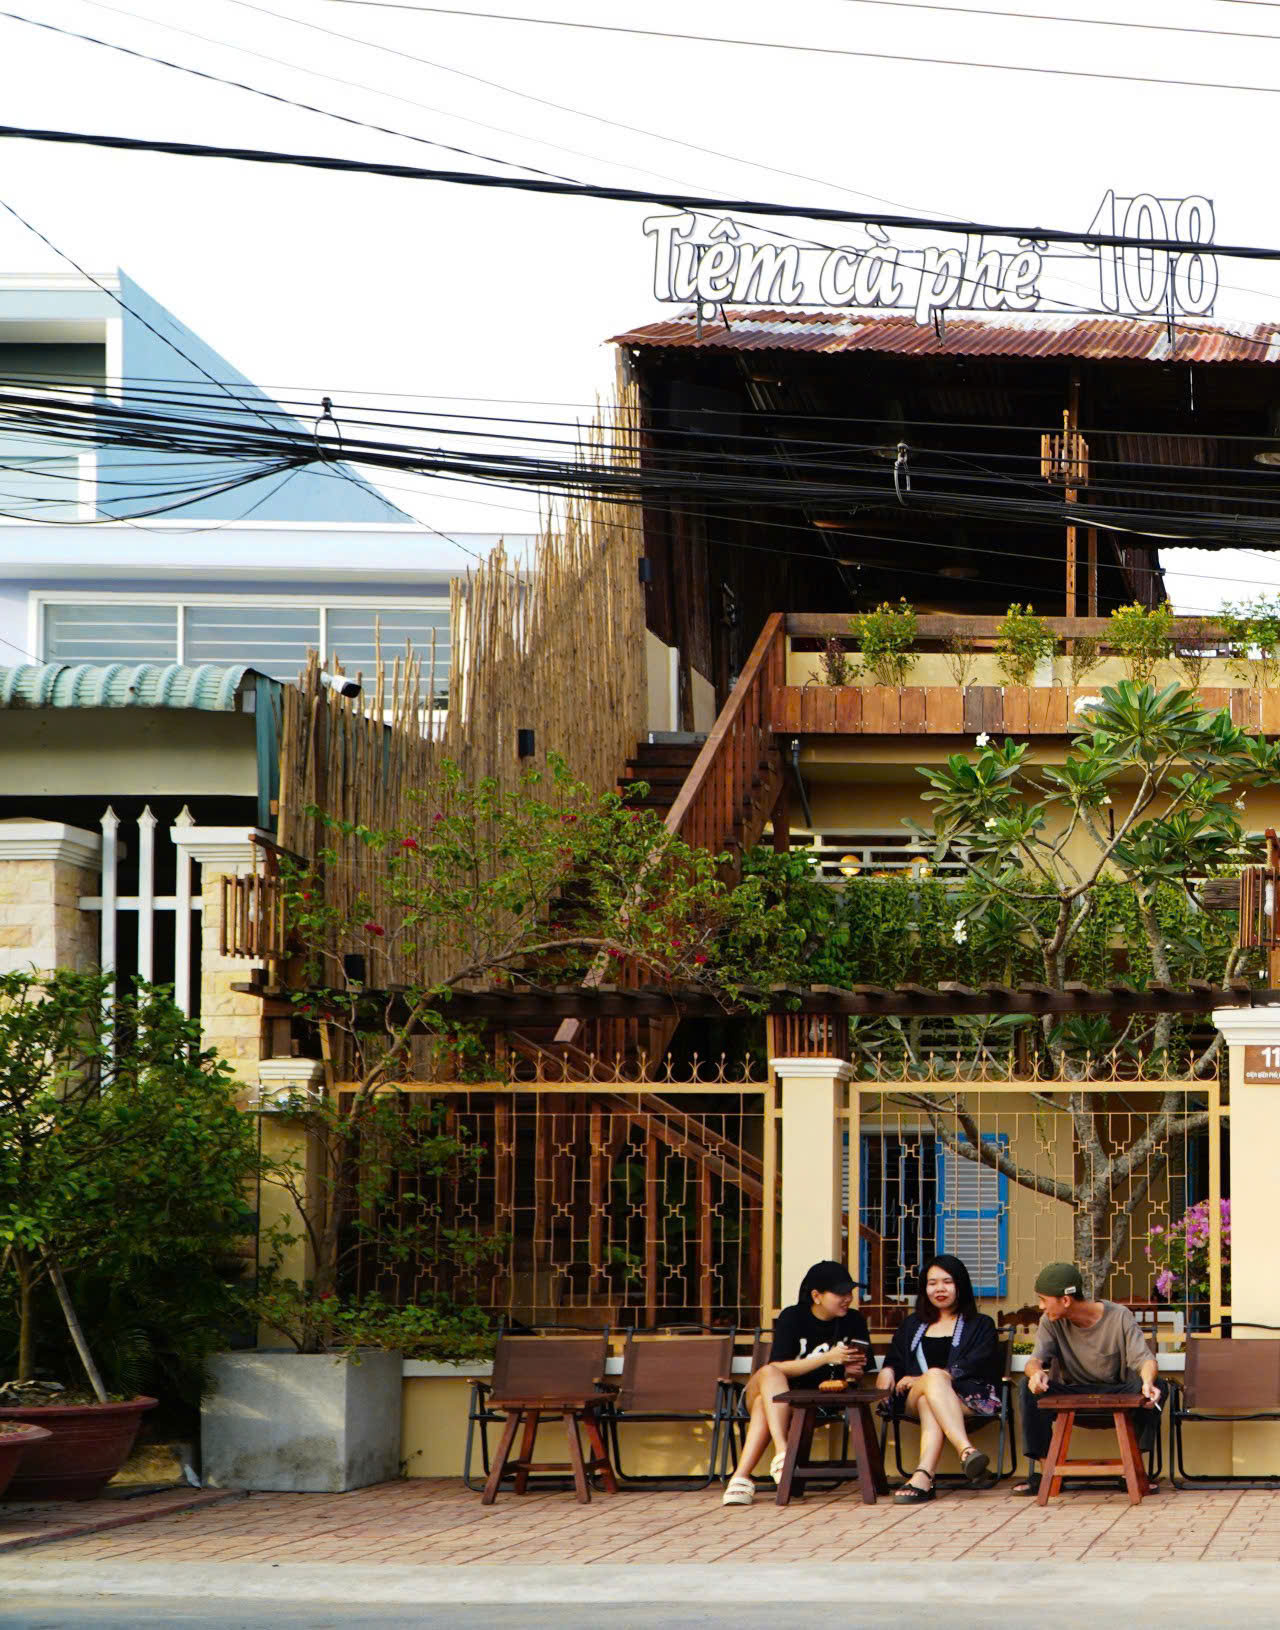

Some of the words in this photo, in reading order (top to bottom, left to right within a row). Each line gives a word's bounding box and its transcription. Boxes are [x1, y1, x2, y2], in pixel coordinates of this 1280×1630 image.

[643, 211, 804, 320] Tiệm
[819, 222, 904, 308] cà
[915, 227, 1043, 326] phê
[1083, 188, 1218, 317] 108
